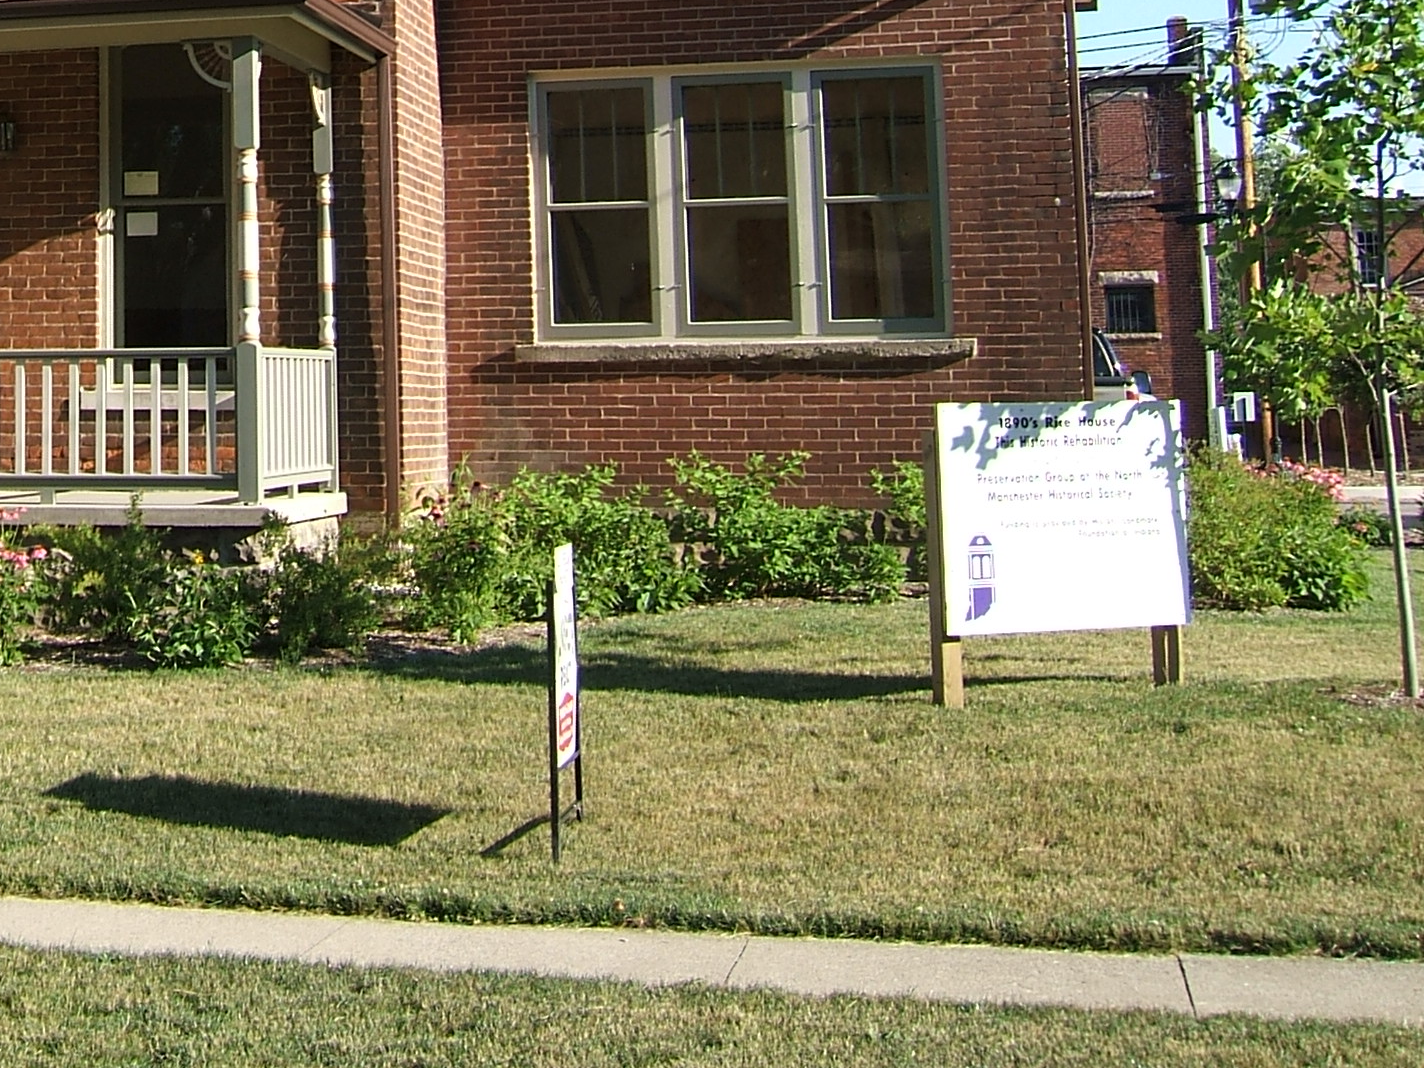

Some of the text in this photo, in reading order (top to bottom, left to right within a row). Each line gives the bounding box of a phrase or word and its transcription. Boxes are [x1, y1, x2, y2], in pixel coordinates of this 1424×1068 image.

[998, 416, 1116, 429] 1890's Rice House
[995, 435, 1014, 448] This
[1019, 435, 1058, 448] Historic
[977, 473, 1040, 485] Preservation
[1045, 471, 1075, 483] Group
[1095, 470, 1111, 481] the
[1114, 469, 1143, 481] North
[987, 487, 1133, 502] Manchester Historical Society
